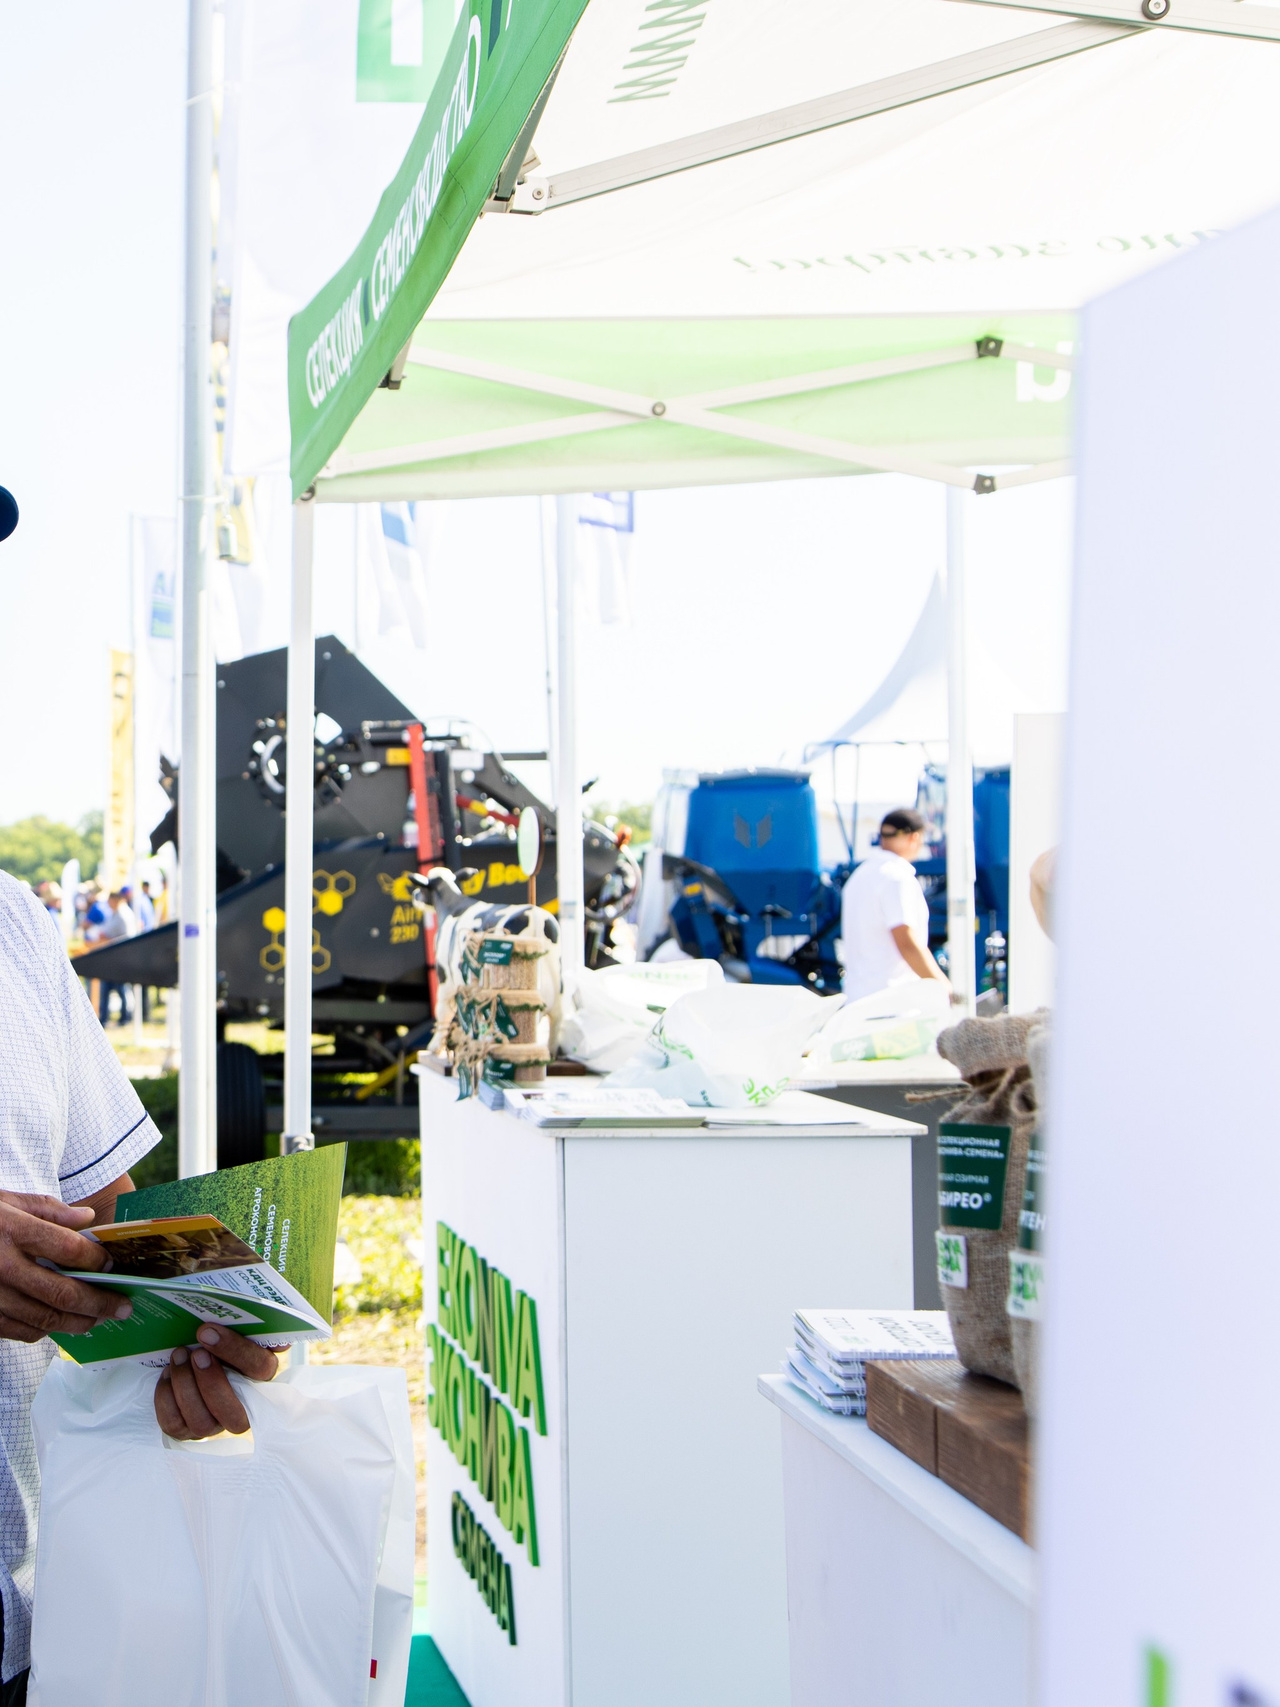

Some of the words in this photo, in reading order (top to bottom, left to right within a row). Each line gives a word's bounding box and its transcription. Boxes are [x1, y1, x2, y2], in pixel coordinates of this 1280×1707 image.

[371, 14, 481, 321] СЕМЕНОВОДСТВО
[389, 924, 420, 945] 230
[246, 1267, 264, 1286] КДЦ
[262, 1204, 276, 1264] СЕМЕНОВО
[278, 1218, 291, 1273] СЕЛЕКЦИЯ
[436, 1221, 547, 1437] EKONIVA
[426, 1323, 541, 1567] ЭКОНИВА
[451, 1490, 518, 1646] СЕМЕНА
